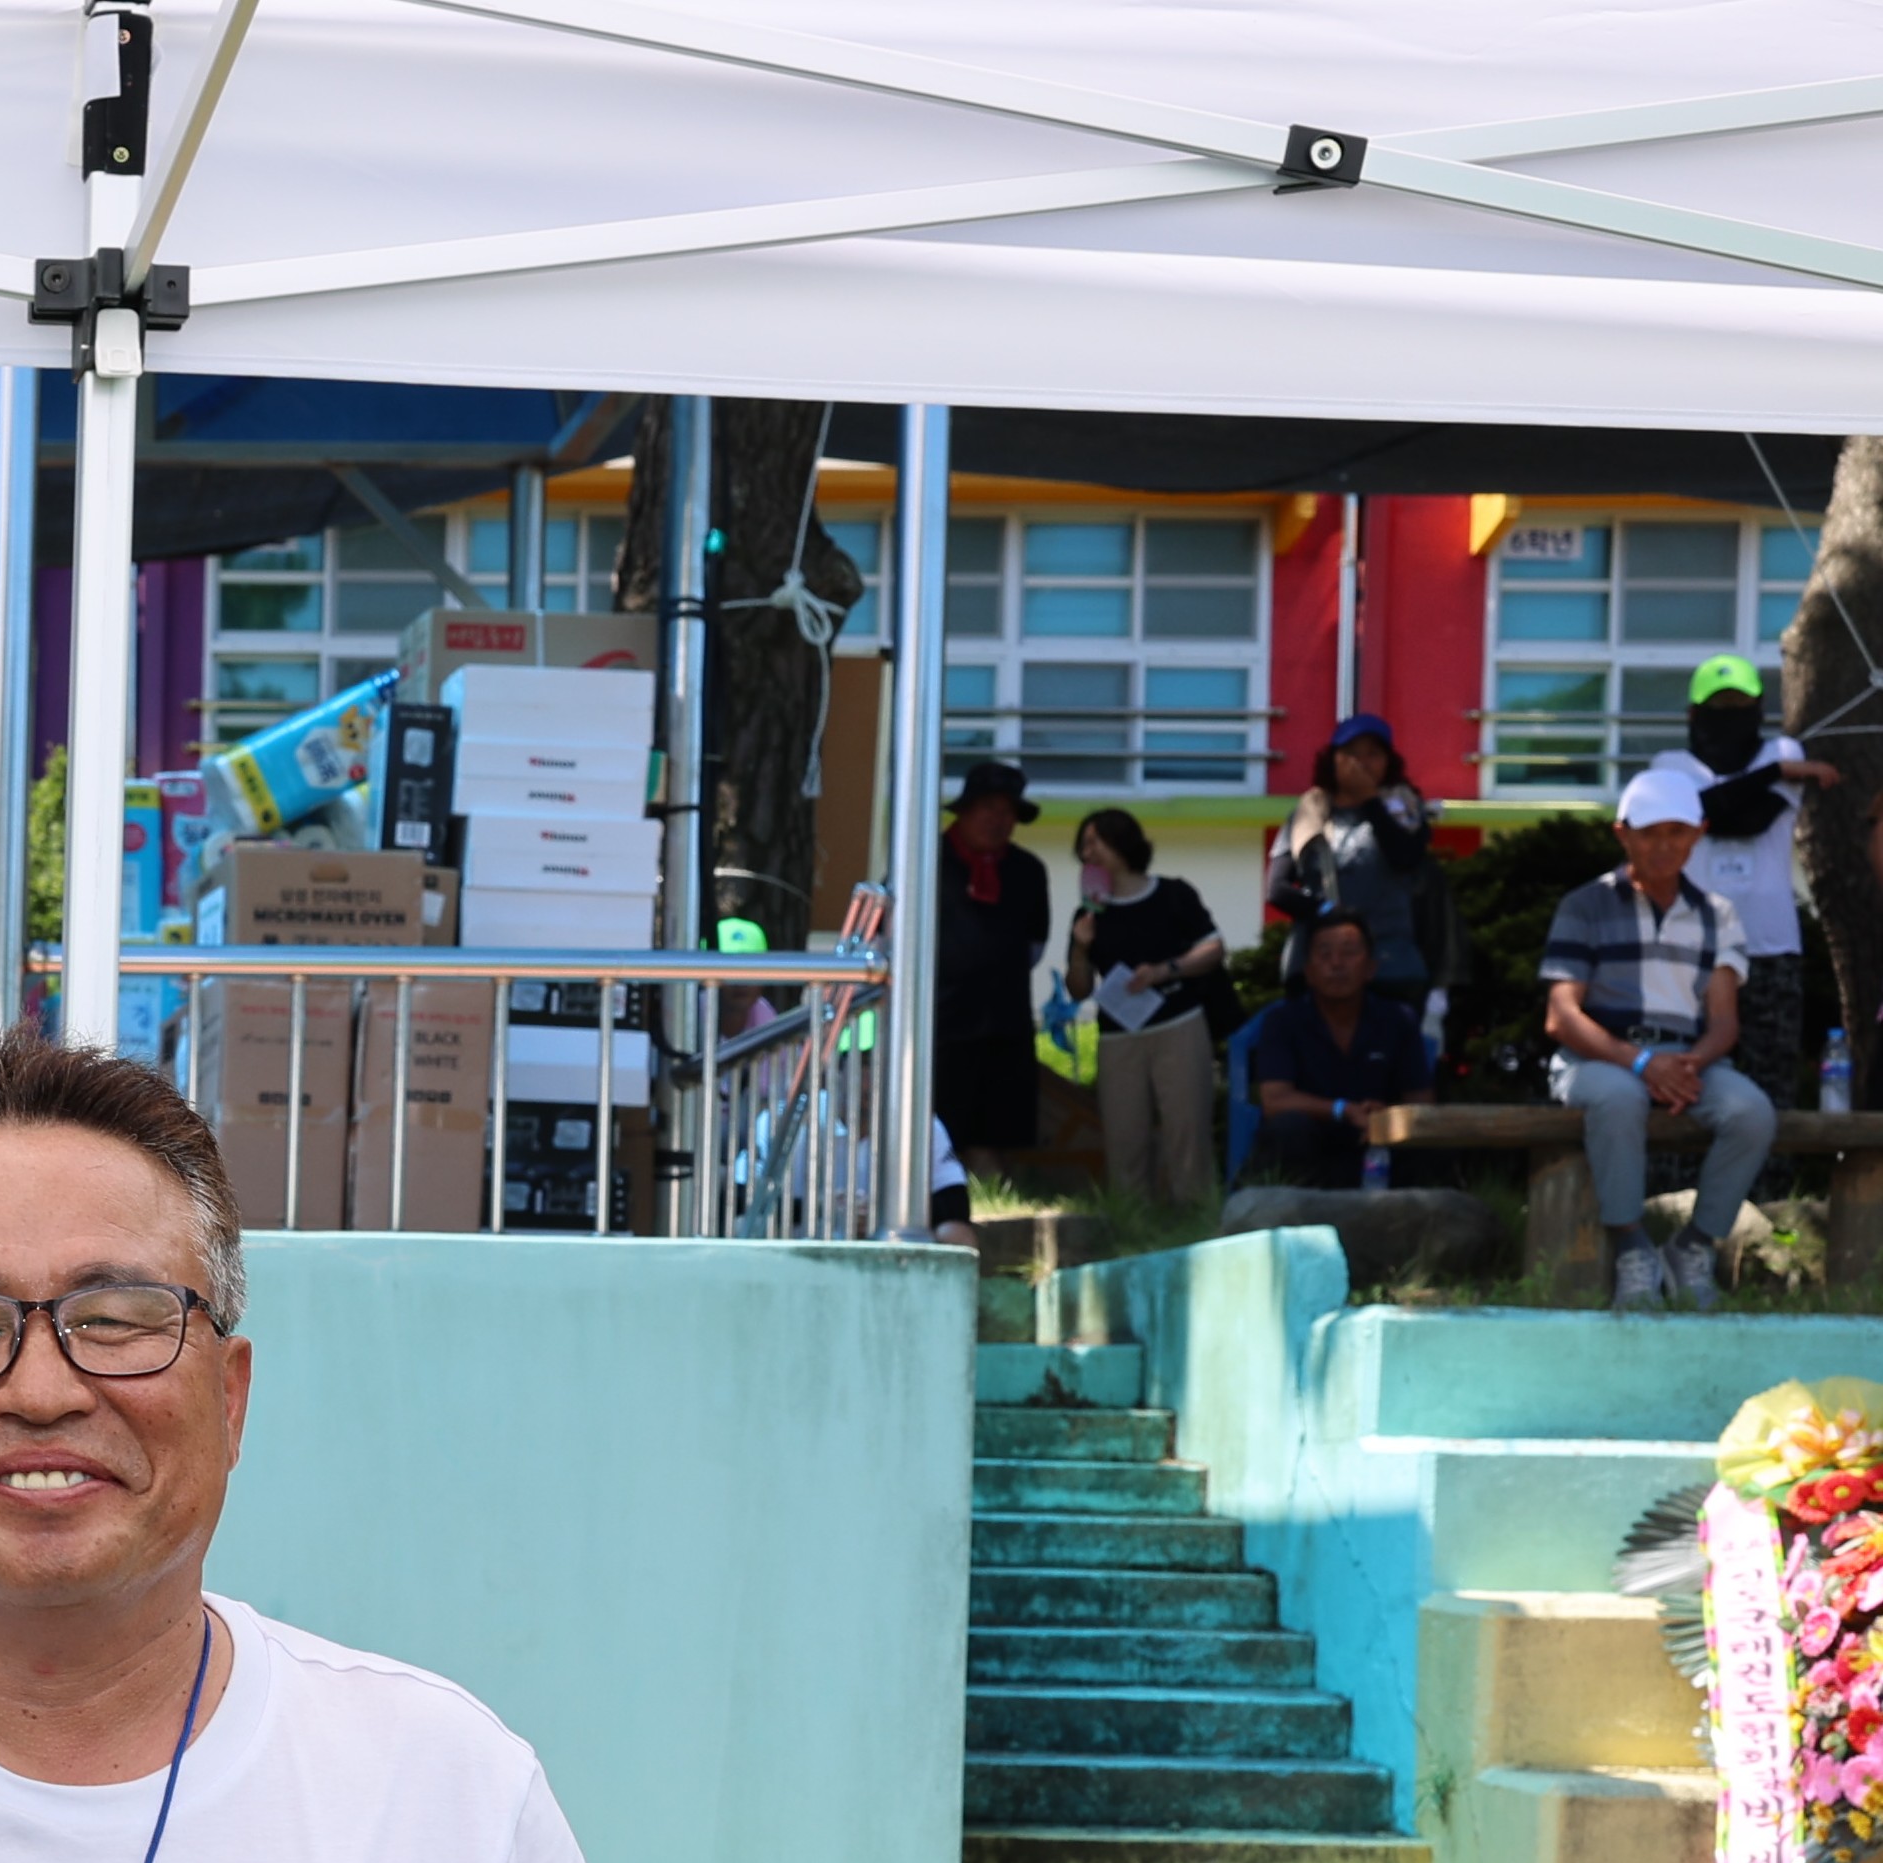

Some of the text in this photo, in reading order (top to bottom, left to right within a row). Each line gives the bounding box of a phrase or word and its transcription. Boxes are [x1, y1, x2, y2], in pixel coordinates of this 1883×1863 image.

[1510, 529, 1573, 556] 6학년
[253, 907, 406, 925] MICROWAVE OVEN
[413, 1030, 462, 1046] BLACK
[413, 1054, 460, 1071] WHITE
